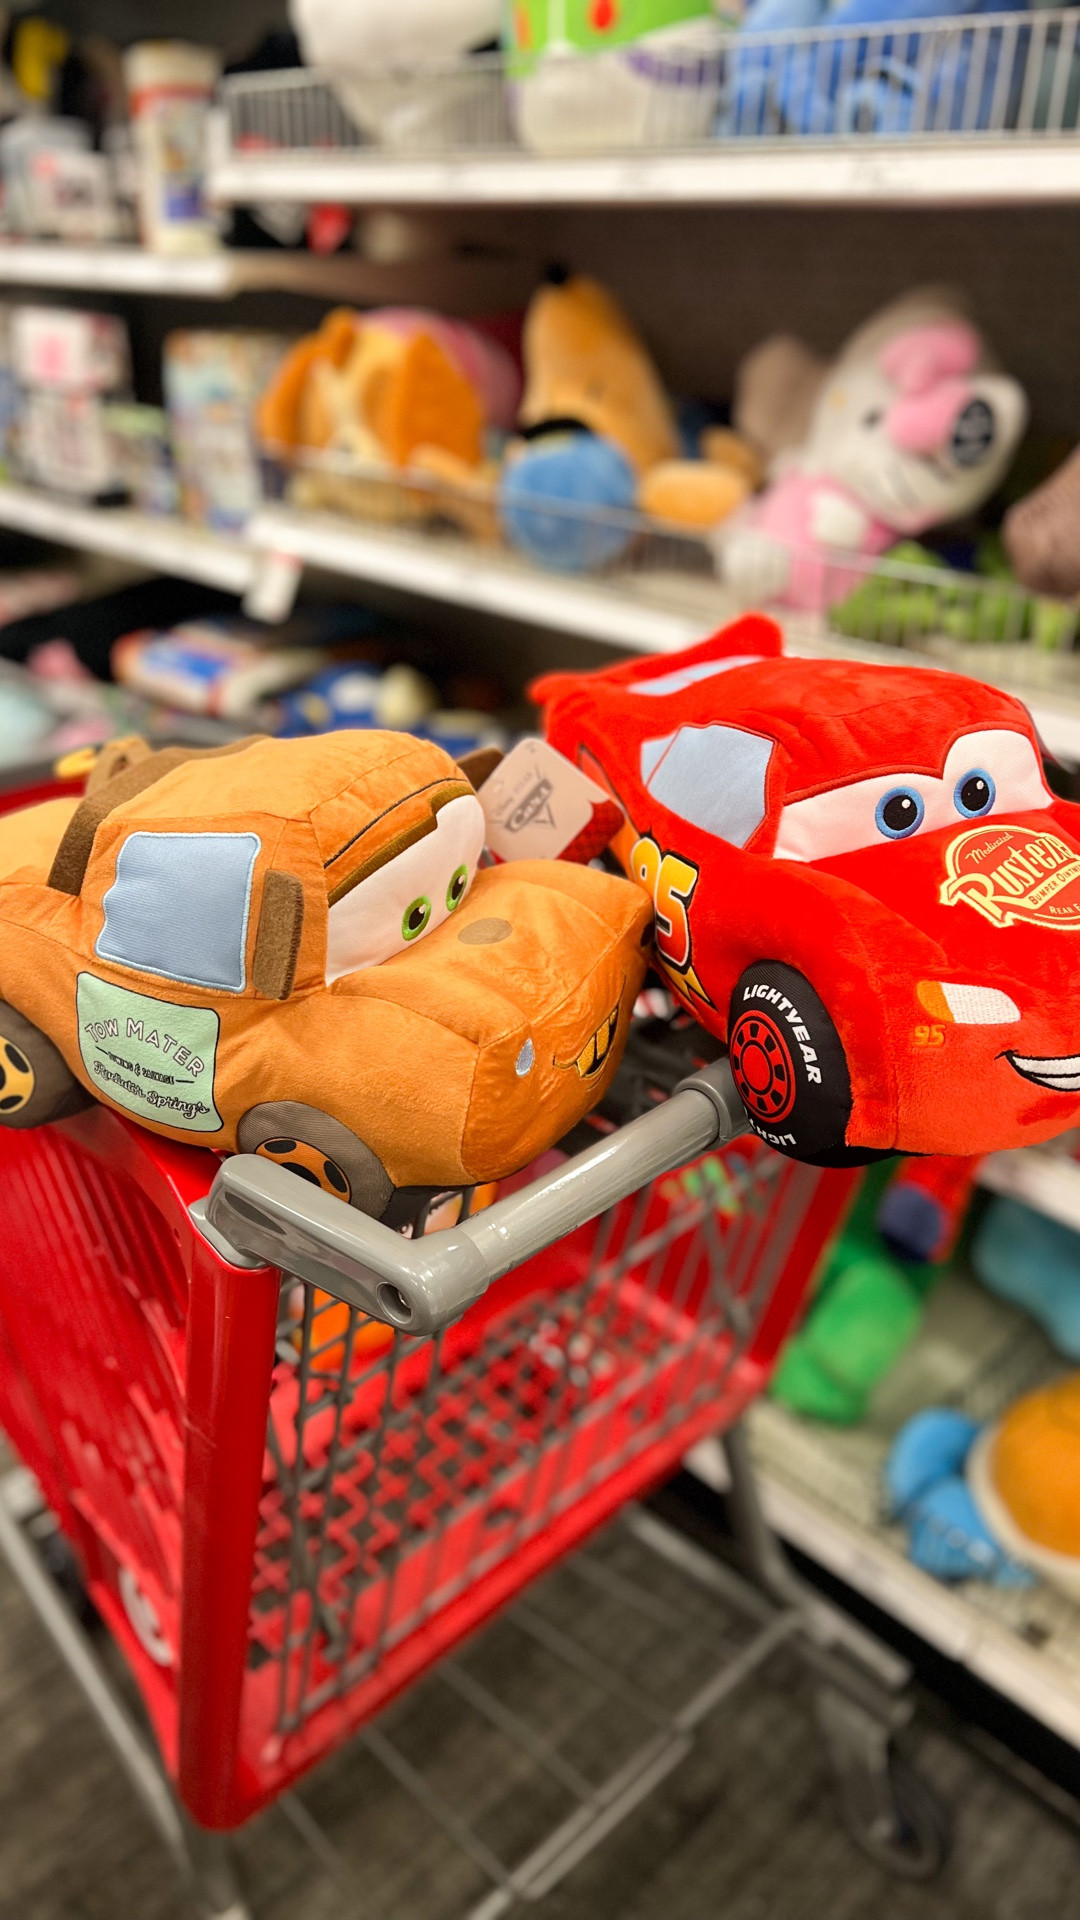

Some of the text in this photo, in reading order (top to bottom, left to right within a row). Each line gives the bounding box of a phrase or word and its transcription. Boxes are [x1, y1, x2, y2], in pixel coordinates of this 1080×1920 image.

[965, 831, 1014, 864] Medicated
[85, 1017, 205, 1077] TOW MATER
[743, 984, 822, 1084] LIGHTYEAR
[913, 1024, 946, 1046] 95
